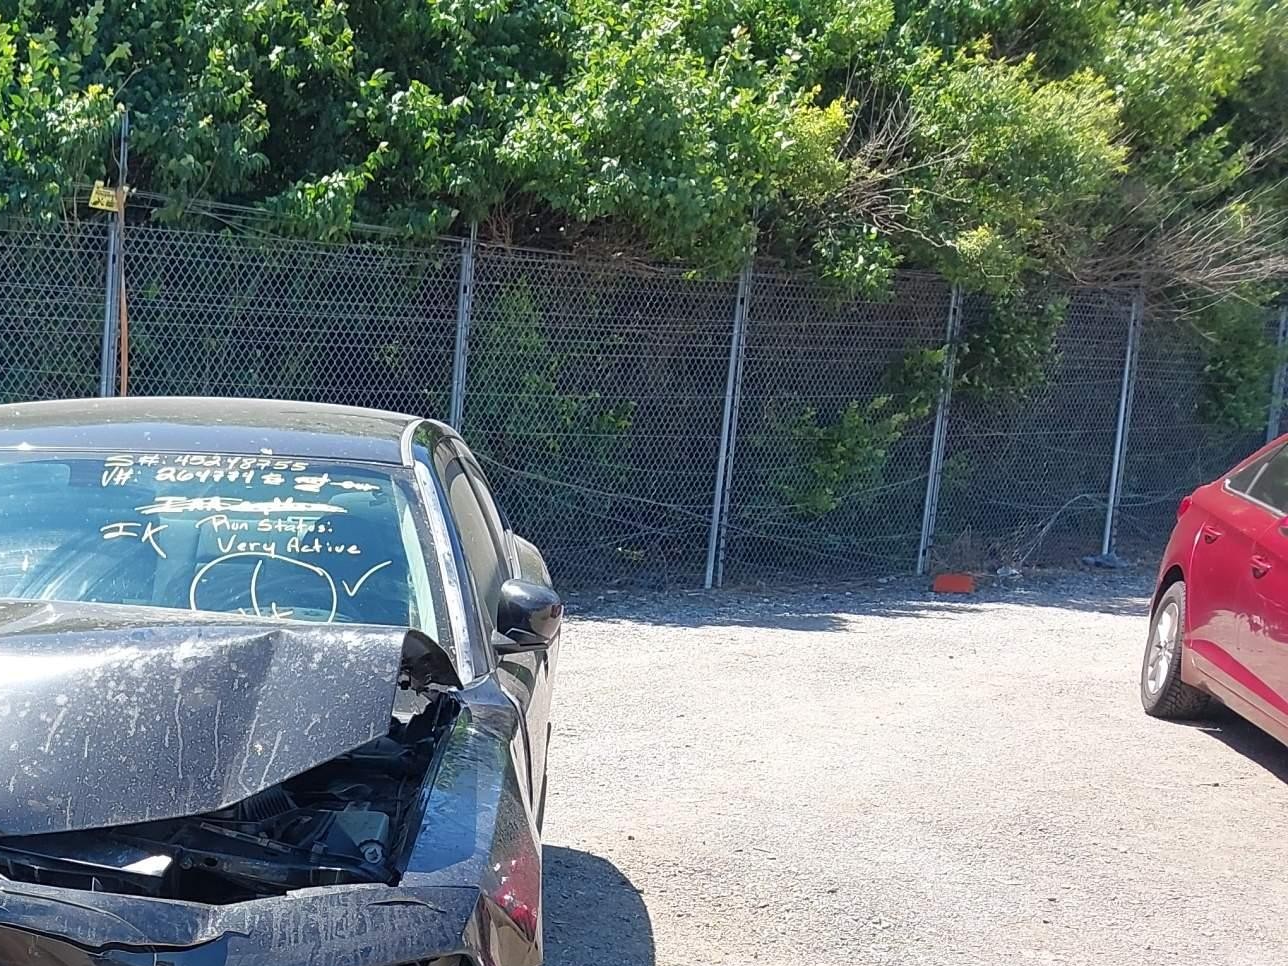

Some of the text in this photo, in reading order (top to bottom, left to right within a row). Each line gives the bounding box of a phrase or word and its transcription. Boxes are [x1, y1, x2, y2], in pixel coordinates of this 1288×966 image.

[174, 455, 309, 473] 45248755
[217, 537, 361, 558] Very Active
